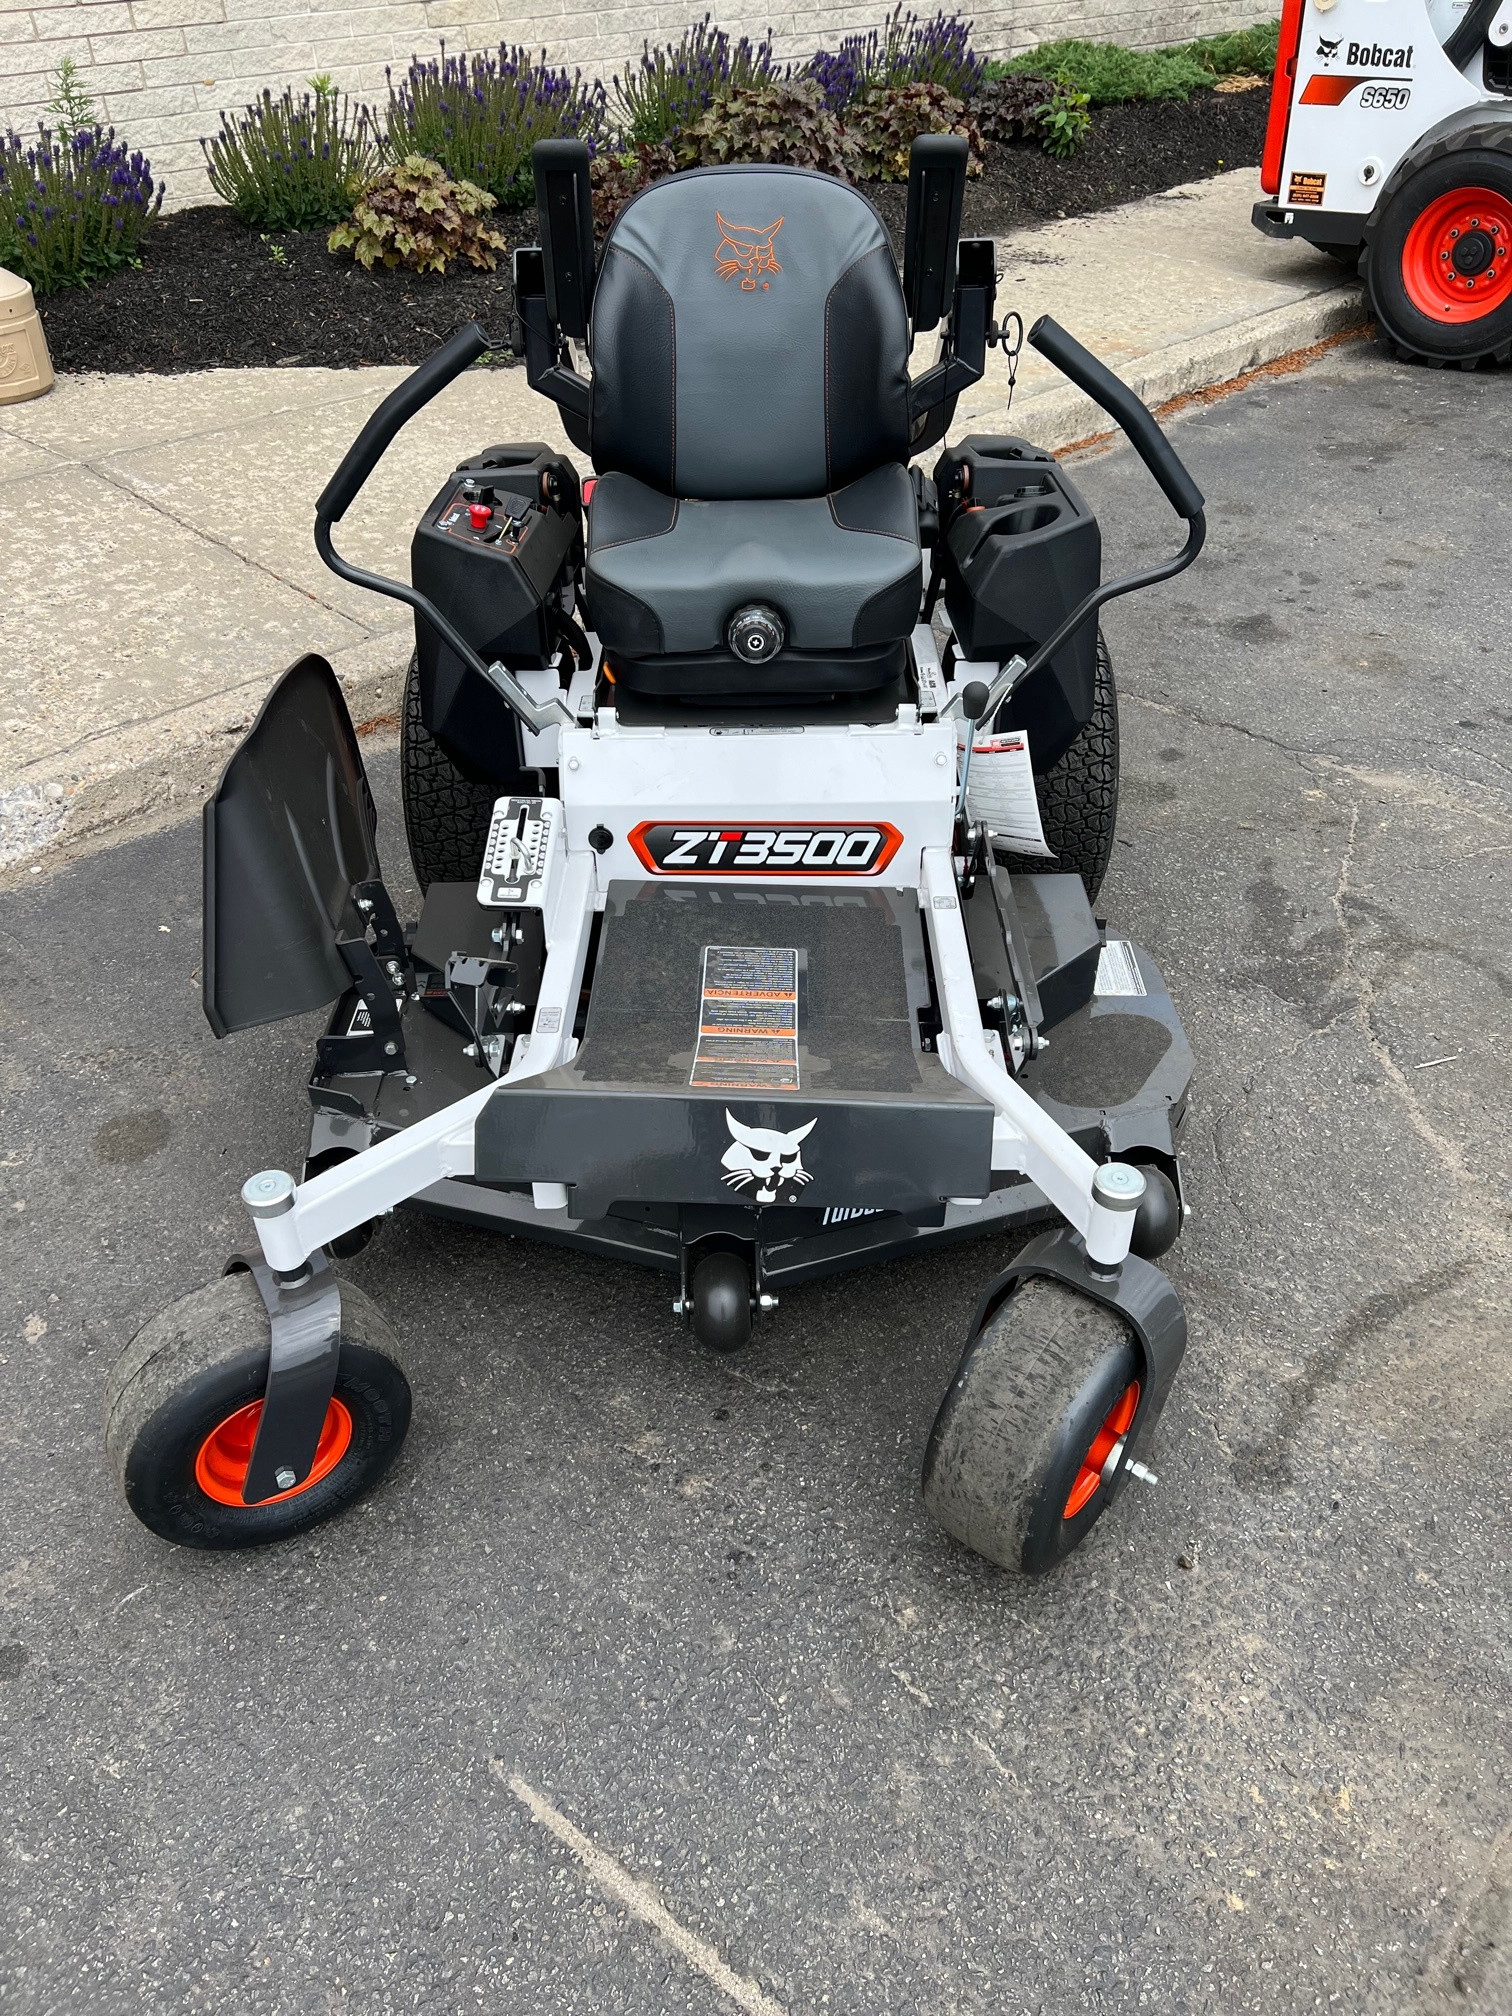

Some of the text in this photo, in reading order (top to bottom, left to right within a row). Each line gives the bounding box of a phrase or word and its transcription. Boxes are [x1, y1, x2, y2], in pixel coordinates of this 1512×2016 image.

[1346, 42, 1414, 69] Bobcat
[1360, 86, 1411, 110] S650
[661, 830, 883, 866] ZT3500
[706, 989, 781, 998] ADVERTENCIA
[717, 1027, 768, 1035] WARNING
